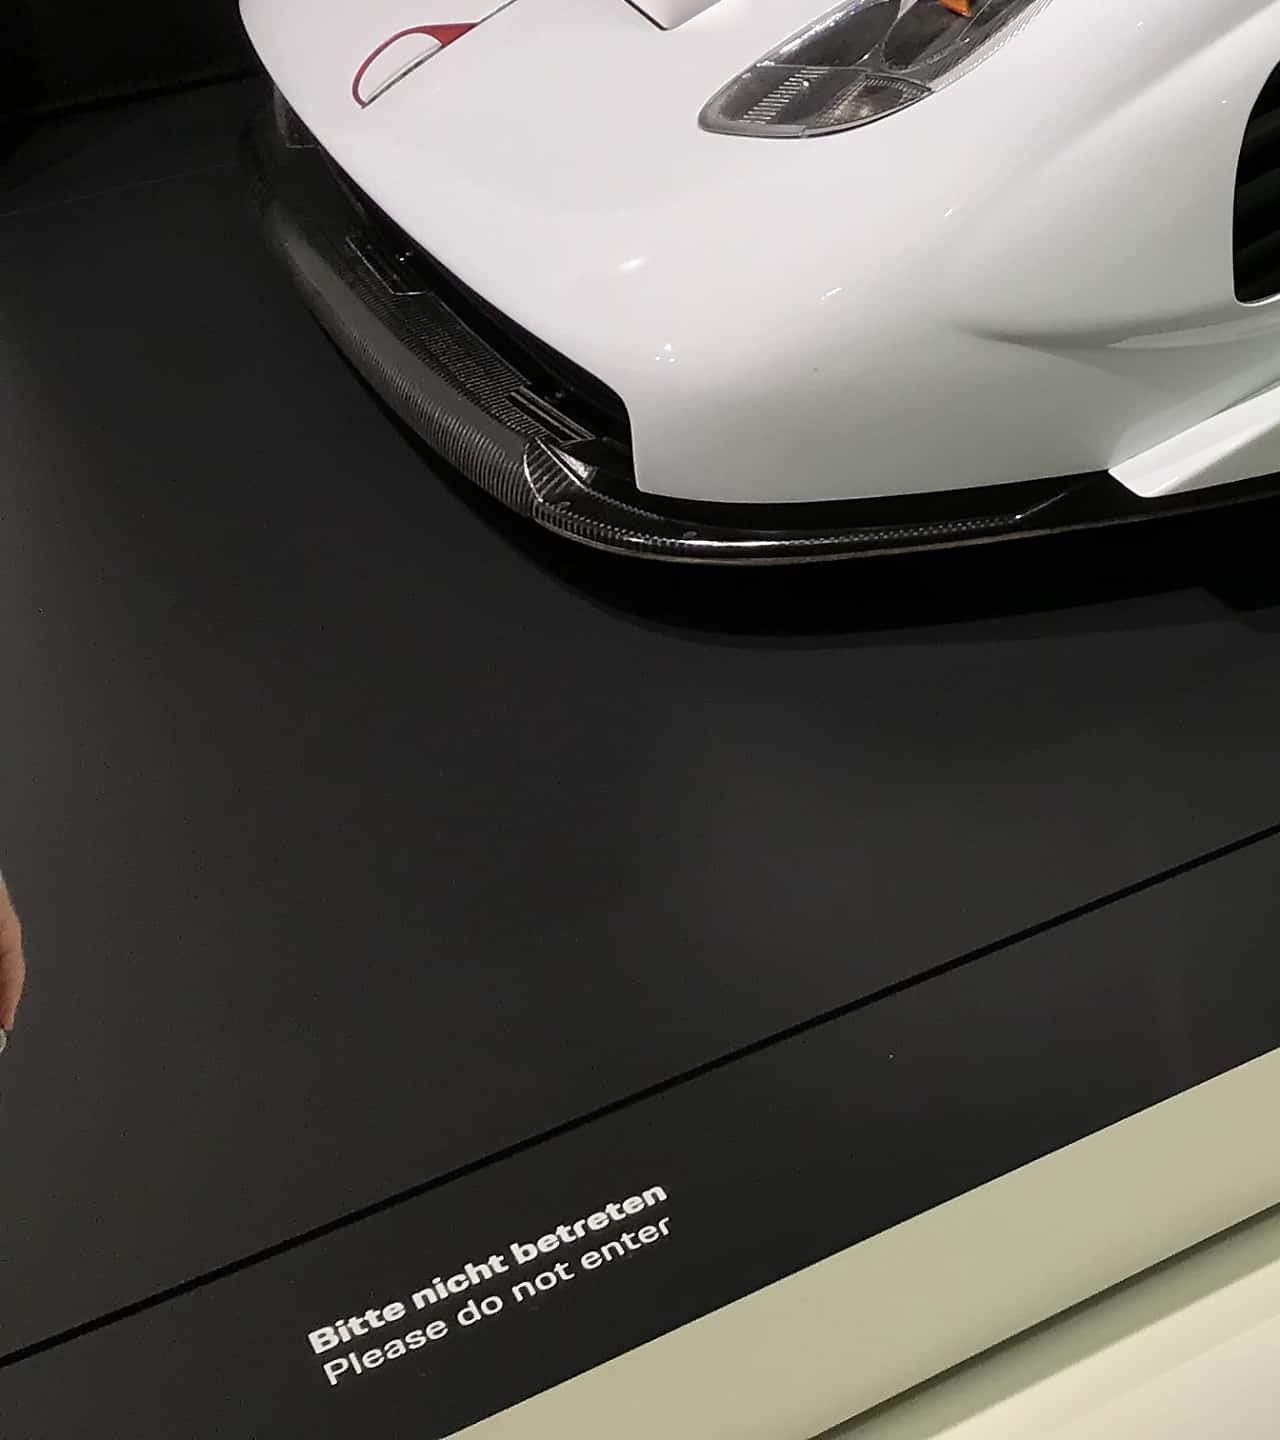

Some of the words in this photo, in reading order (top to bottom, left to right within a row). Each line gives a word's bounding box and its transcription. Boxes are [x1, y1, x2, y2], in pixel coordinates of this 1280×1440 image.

[307, 1300, 406, 1354] Bitte
[411, 1253, 510, 1310] nicht
[509, 1185, 669, 1264] betreten
[323, 1319, 449, 1386] Please
[456, 1294, 504, 1327] do
[511, 1262, 576, 1303] not
[580, 1216, 672, 1271] enter
